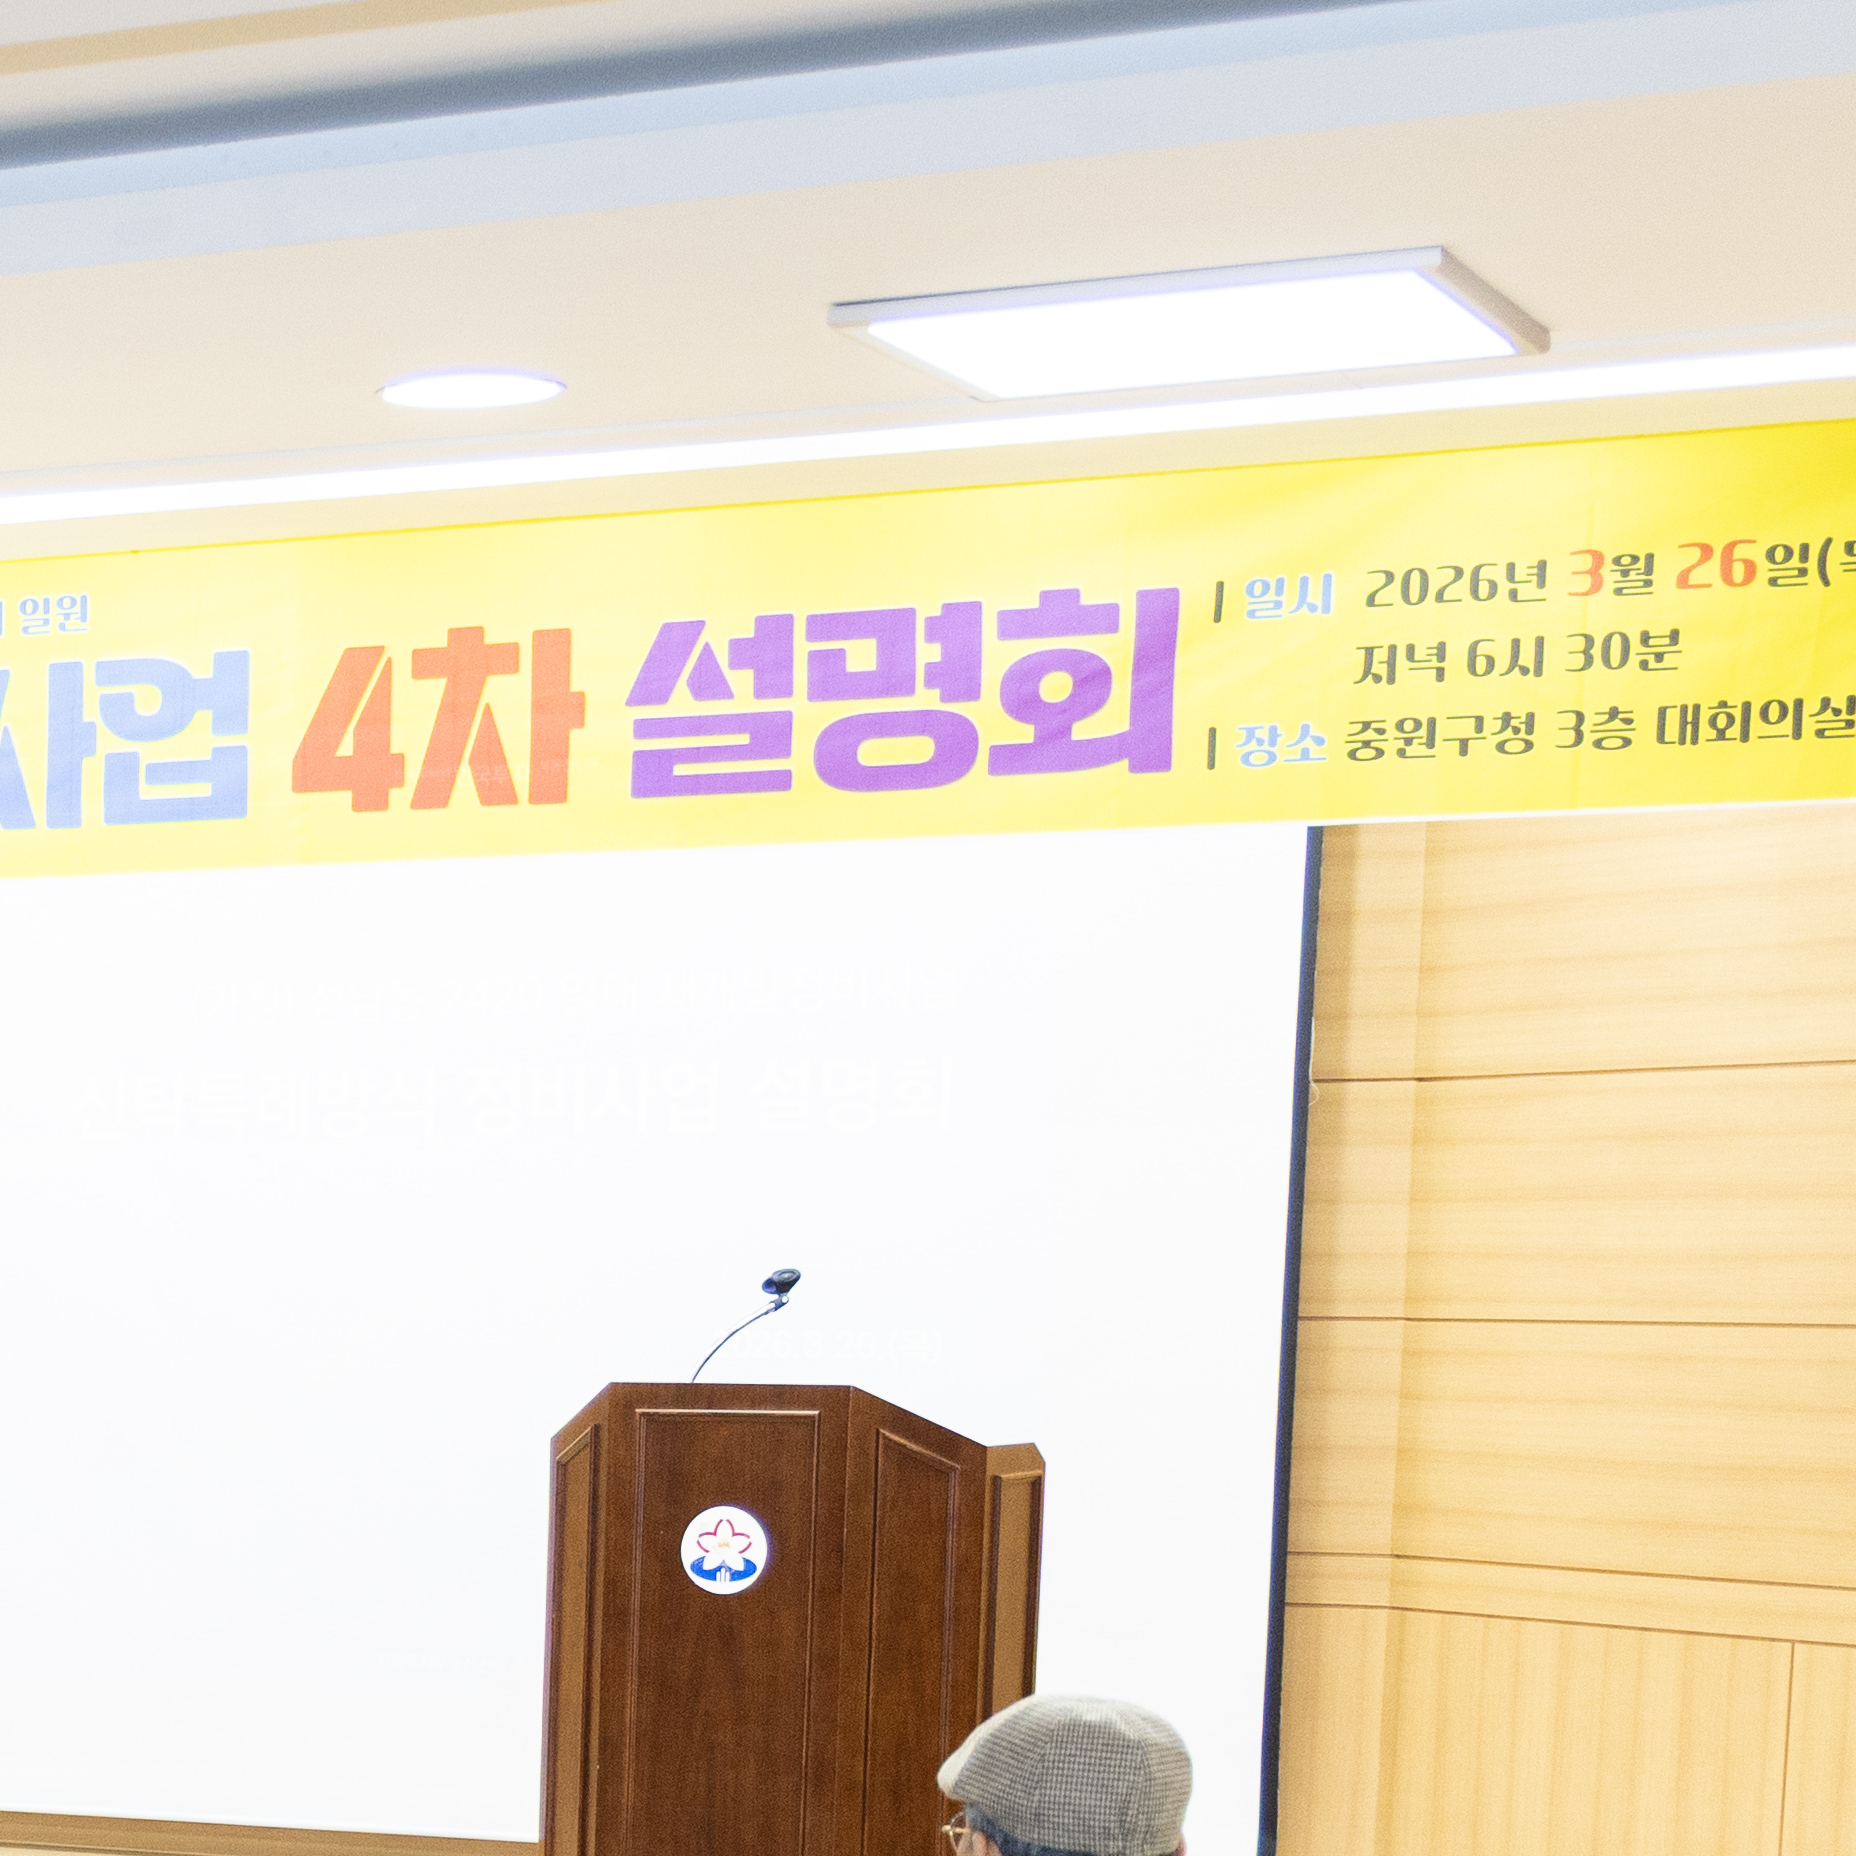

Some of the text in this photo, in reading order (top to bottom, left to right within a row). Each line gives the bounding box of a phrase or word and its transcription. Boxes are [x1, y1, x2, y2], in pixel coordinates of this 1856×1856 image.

[18, 594, 89, 636] 일원
[1244, 572, 1335, 620] 일시
[1364, 558, 1548, 608] 2026년
[1567, 549, 1657, 598] 3월
[1353, 628, 1683, 686] 저녁 6시 30분
[291, 625, 586, 813] 4차
[624, 586, 1180, 800] 설명회
[1234, 721, 1328, 769] 장소
[1344, 710, 1537, 763] 중원구청
[1554, 706, 1638, 752] 3층
